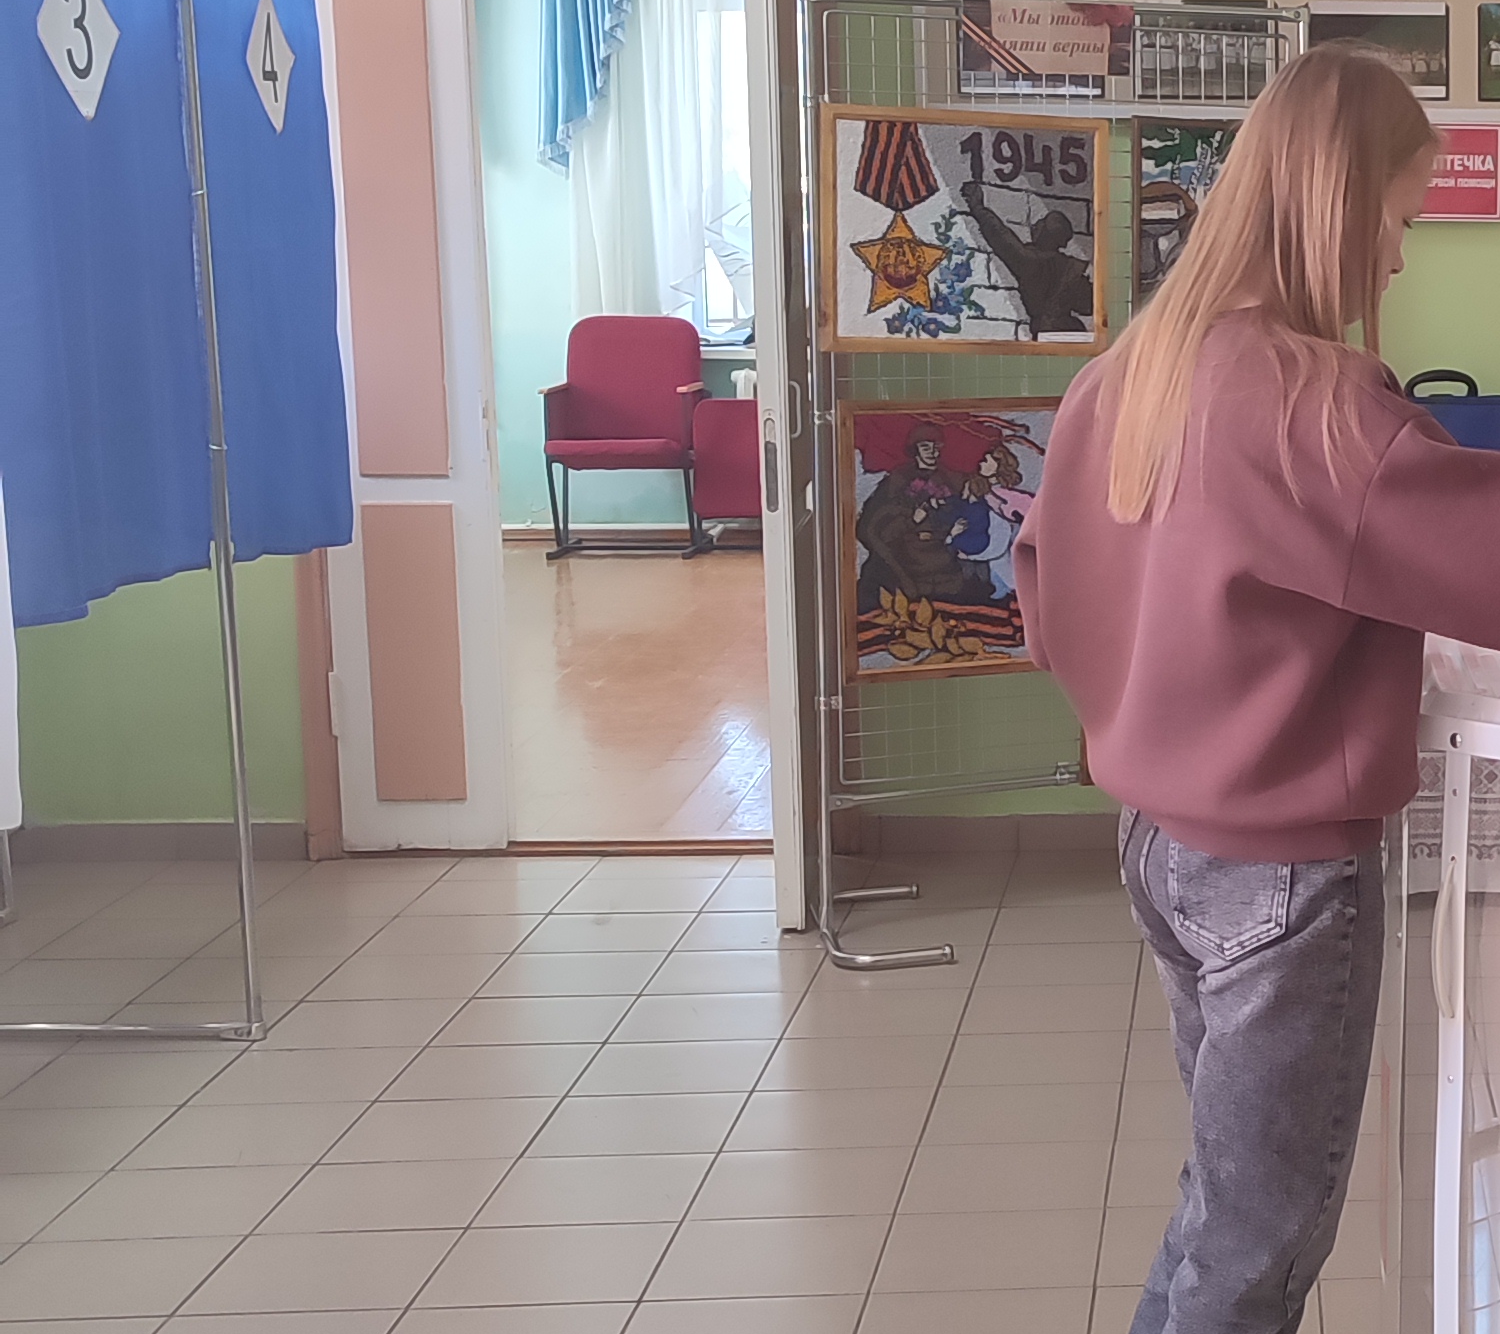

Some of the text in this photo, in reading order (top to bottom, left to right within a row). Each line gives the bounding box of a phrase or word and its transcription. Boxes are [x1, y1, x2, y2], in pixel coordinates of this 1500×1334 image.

[997, 8, 1040, 26] «Мы
[262, 12, 279, 103] 4
[959, 130, 1088, 187] 1945
[1432, 154, 1495, 172] ПТЕЧКА
